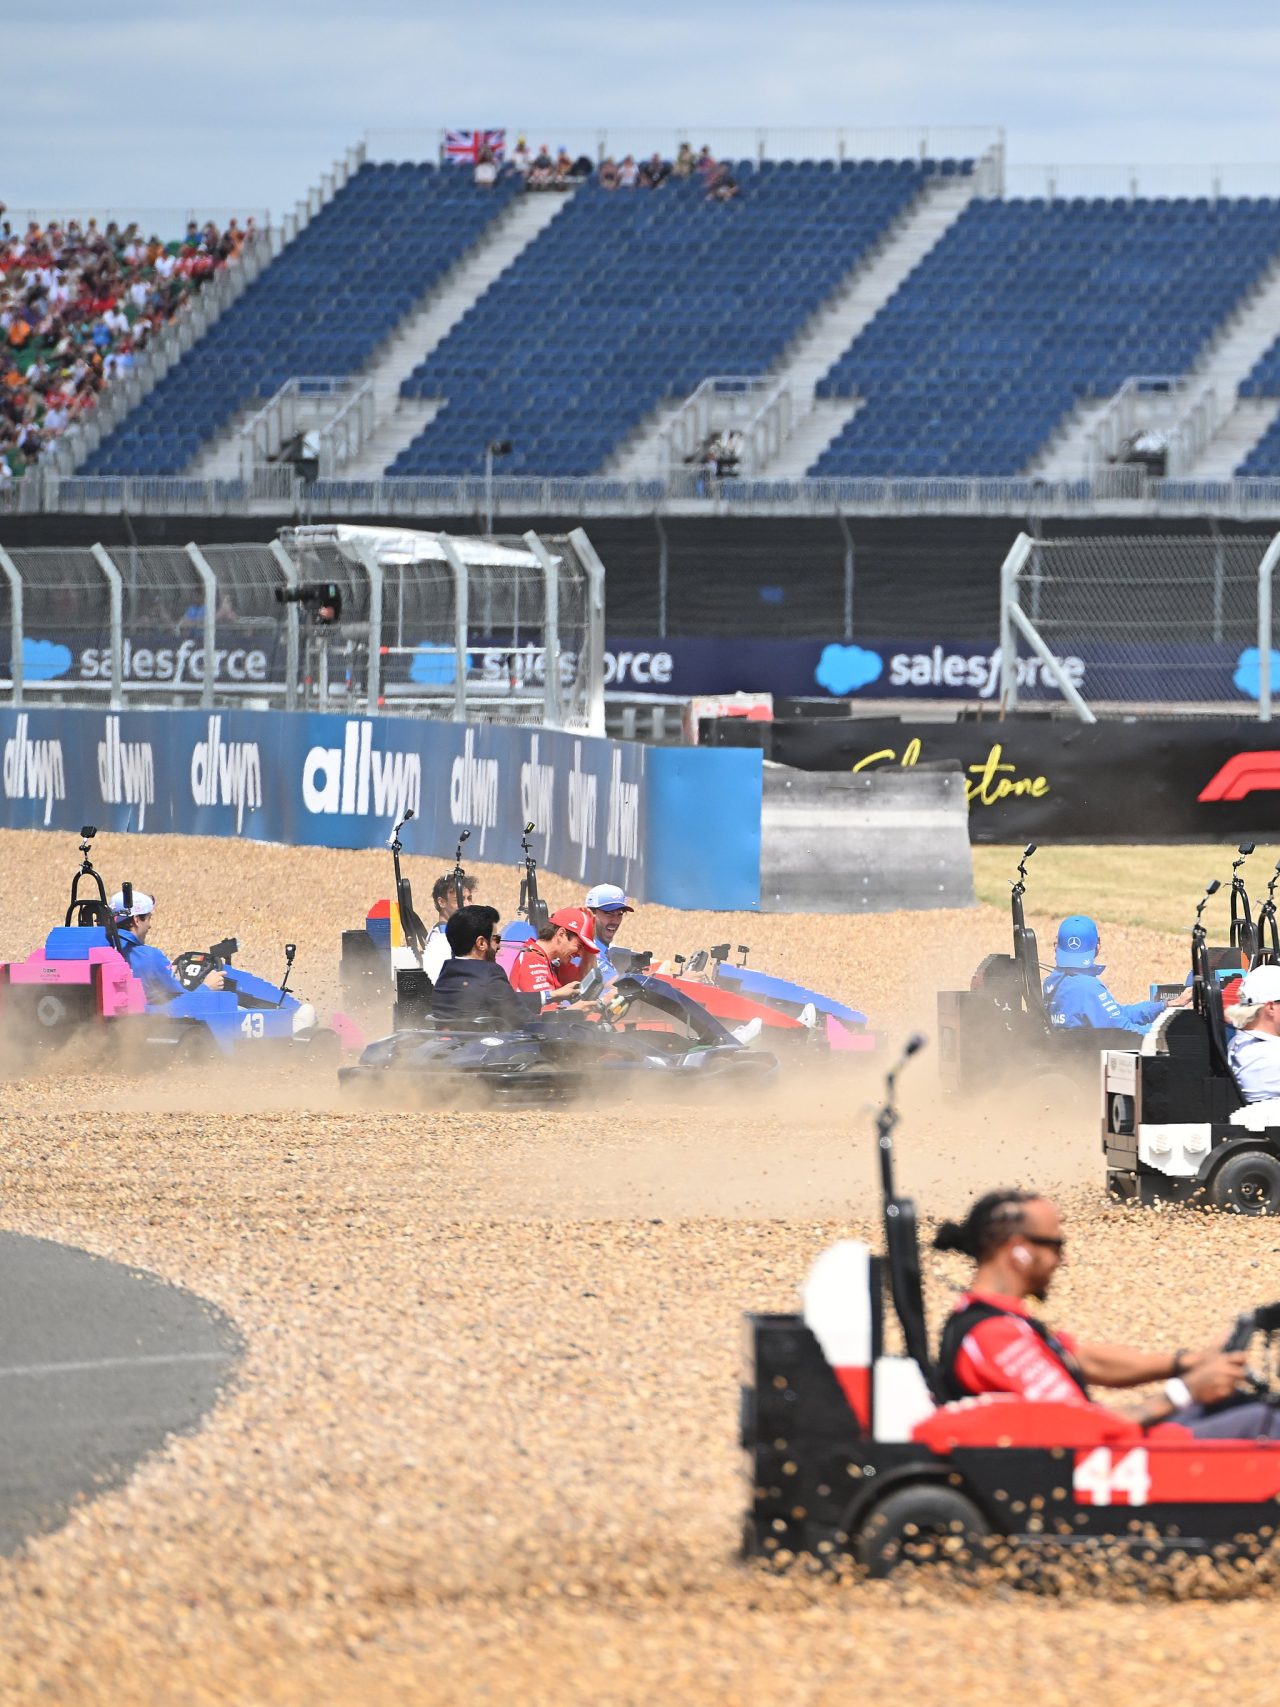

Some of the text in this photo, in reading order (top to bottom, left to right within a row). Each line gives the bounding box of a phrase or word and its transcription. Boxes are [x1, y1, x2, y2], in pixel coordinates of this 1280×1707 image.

[80, 637, 267, 684] salesforce
[481, 640, 674, 690] slesorce
[240, 1012, 264, 1039] 43
[1072, 1446, 1152, 1507] 44
